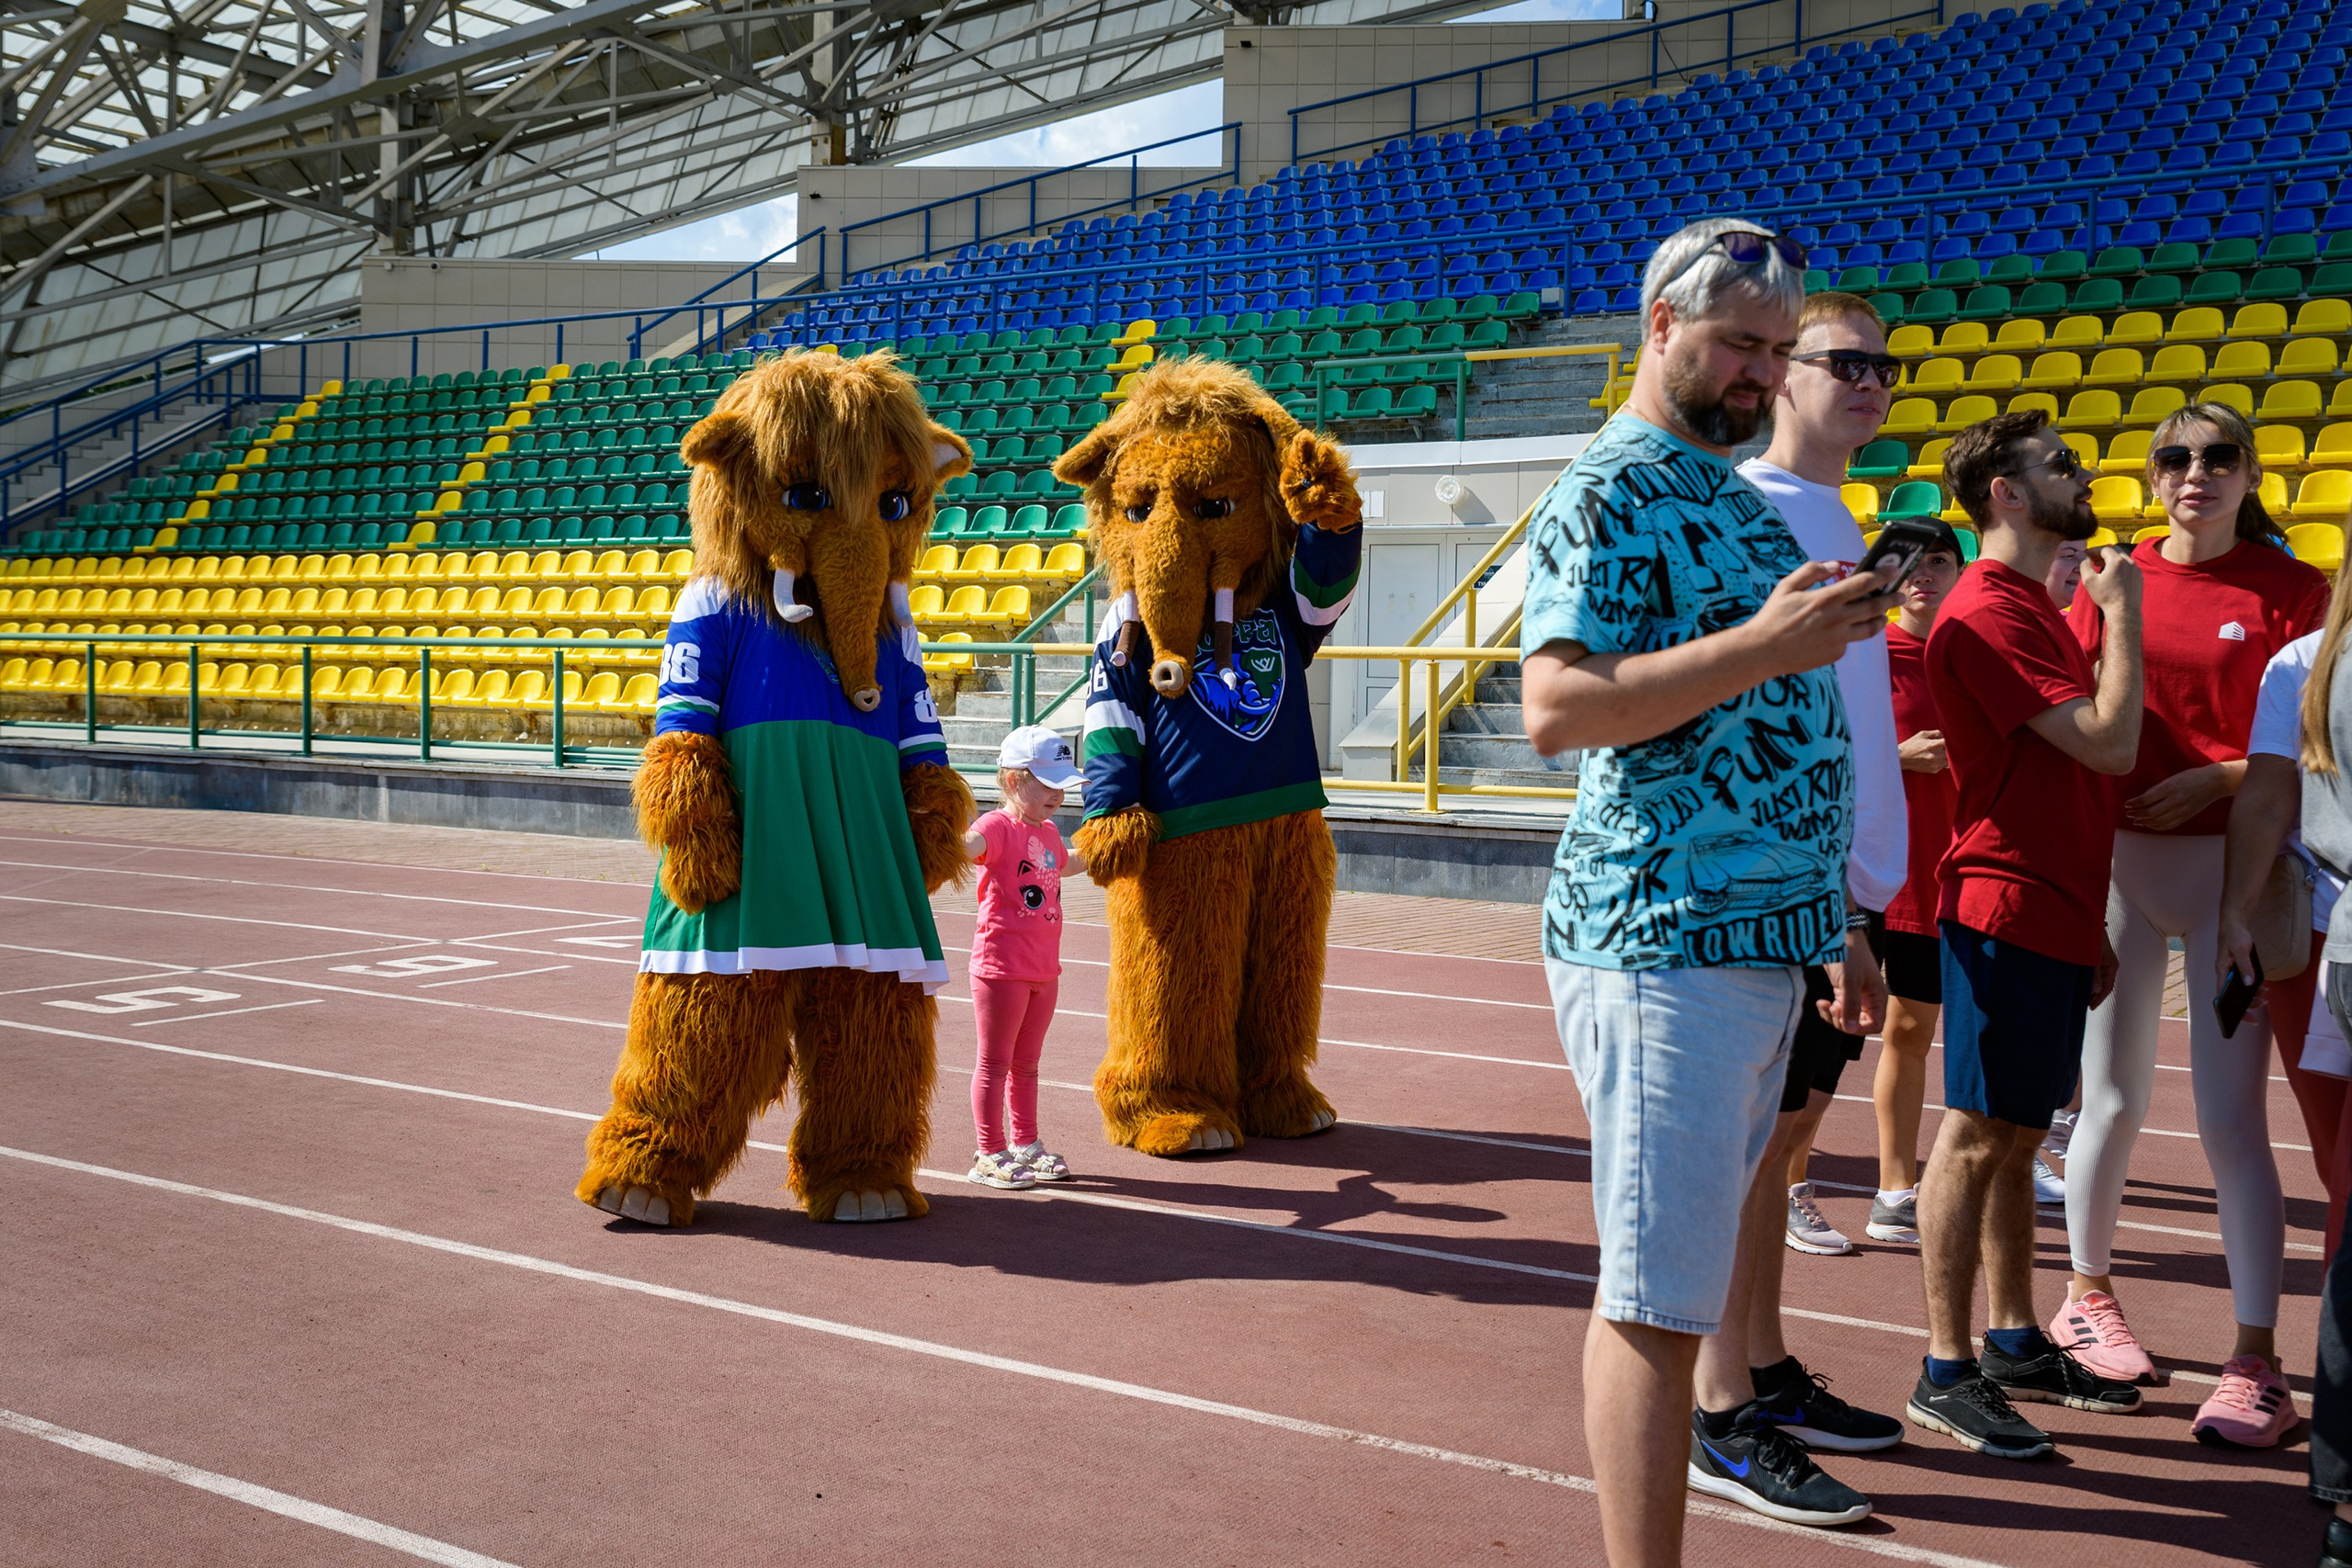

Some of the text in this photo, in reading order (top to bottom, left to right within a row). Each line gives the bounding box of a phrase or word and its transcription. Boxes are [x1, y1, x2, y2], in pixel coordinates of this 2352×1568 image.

[659, 642, 701, 688] 86
[1086, 659, 1109, 700] 6
[1702, 714, 1814, 815] FUN
[1749, 779, 1803, 828] JUST
[1684, 891, 1842, 967] LOWRIDER
